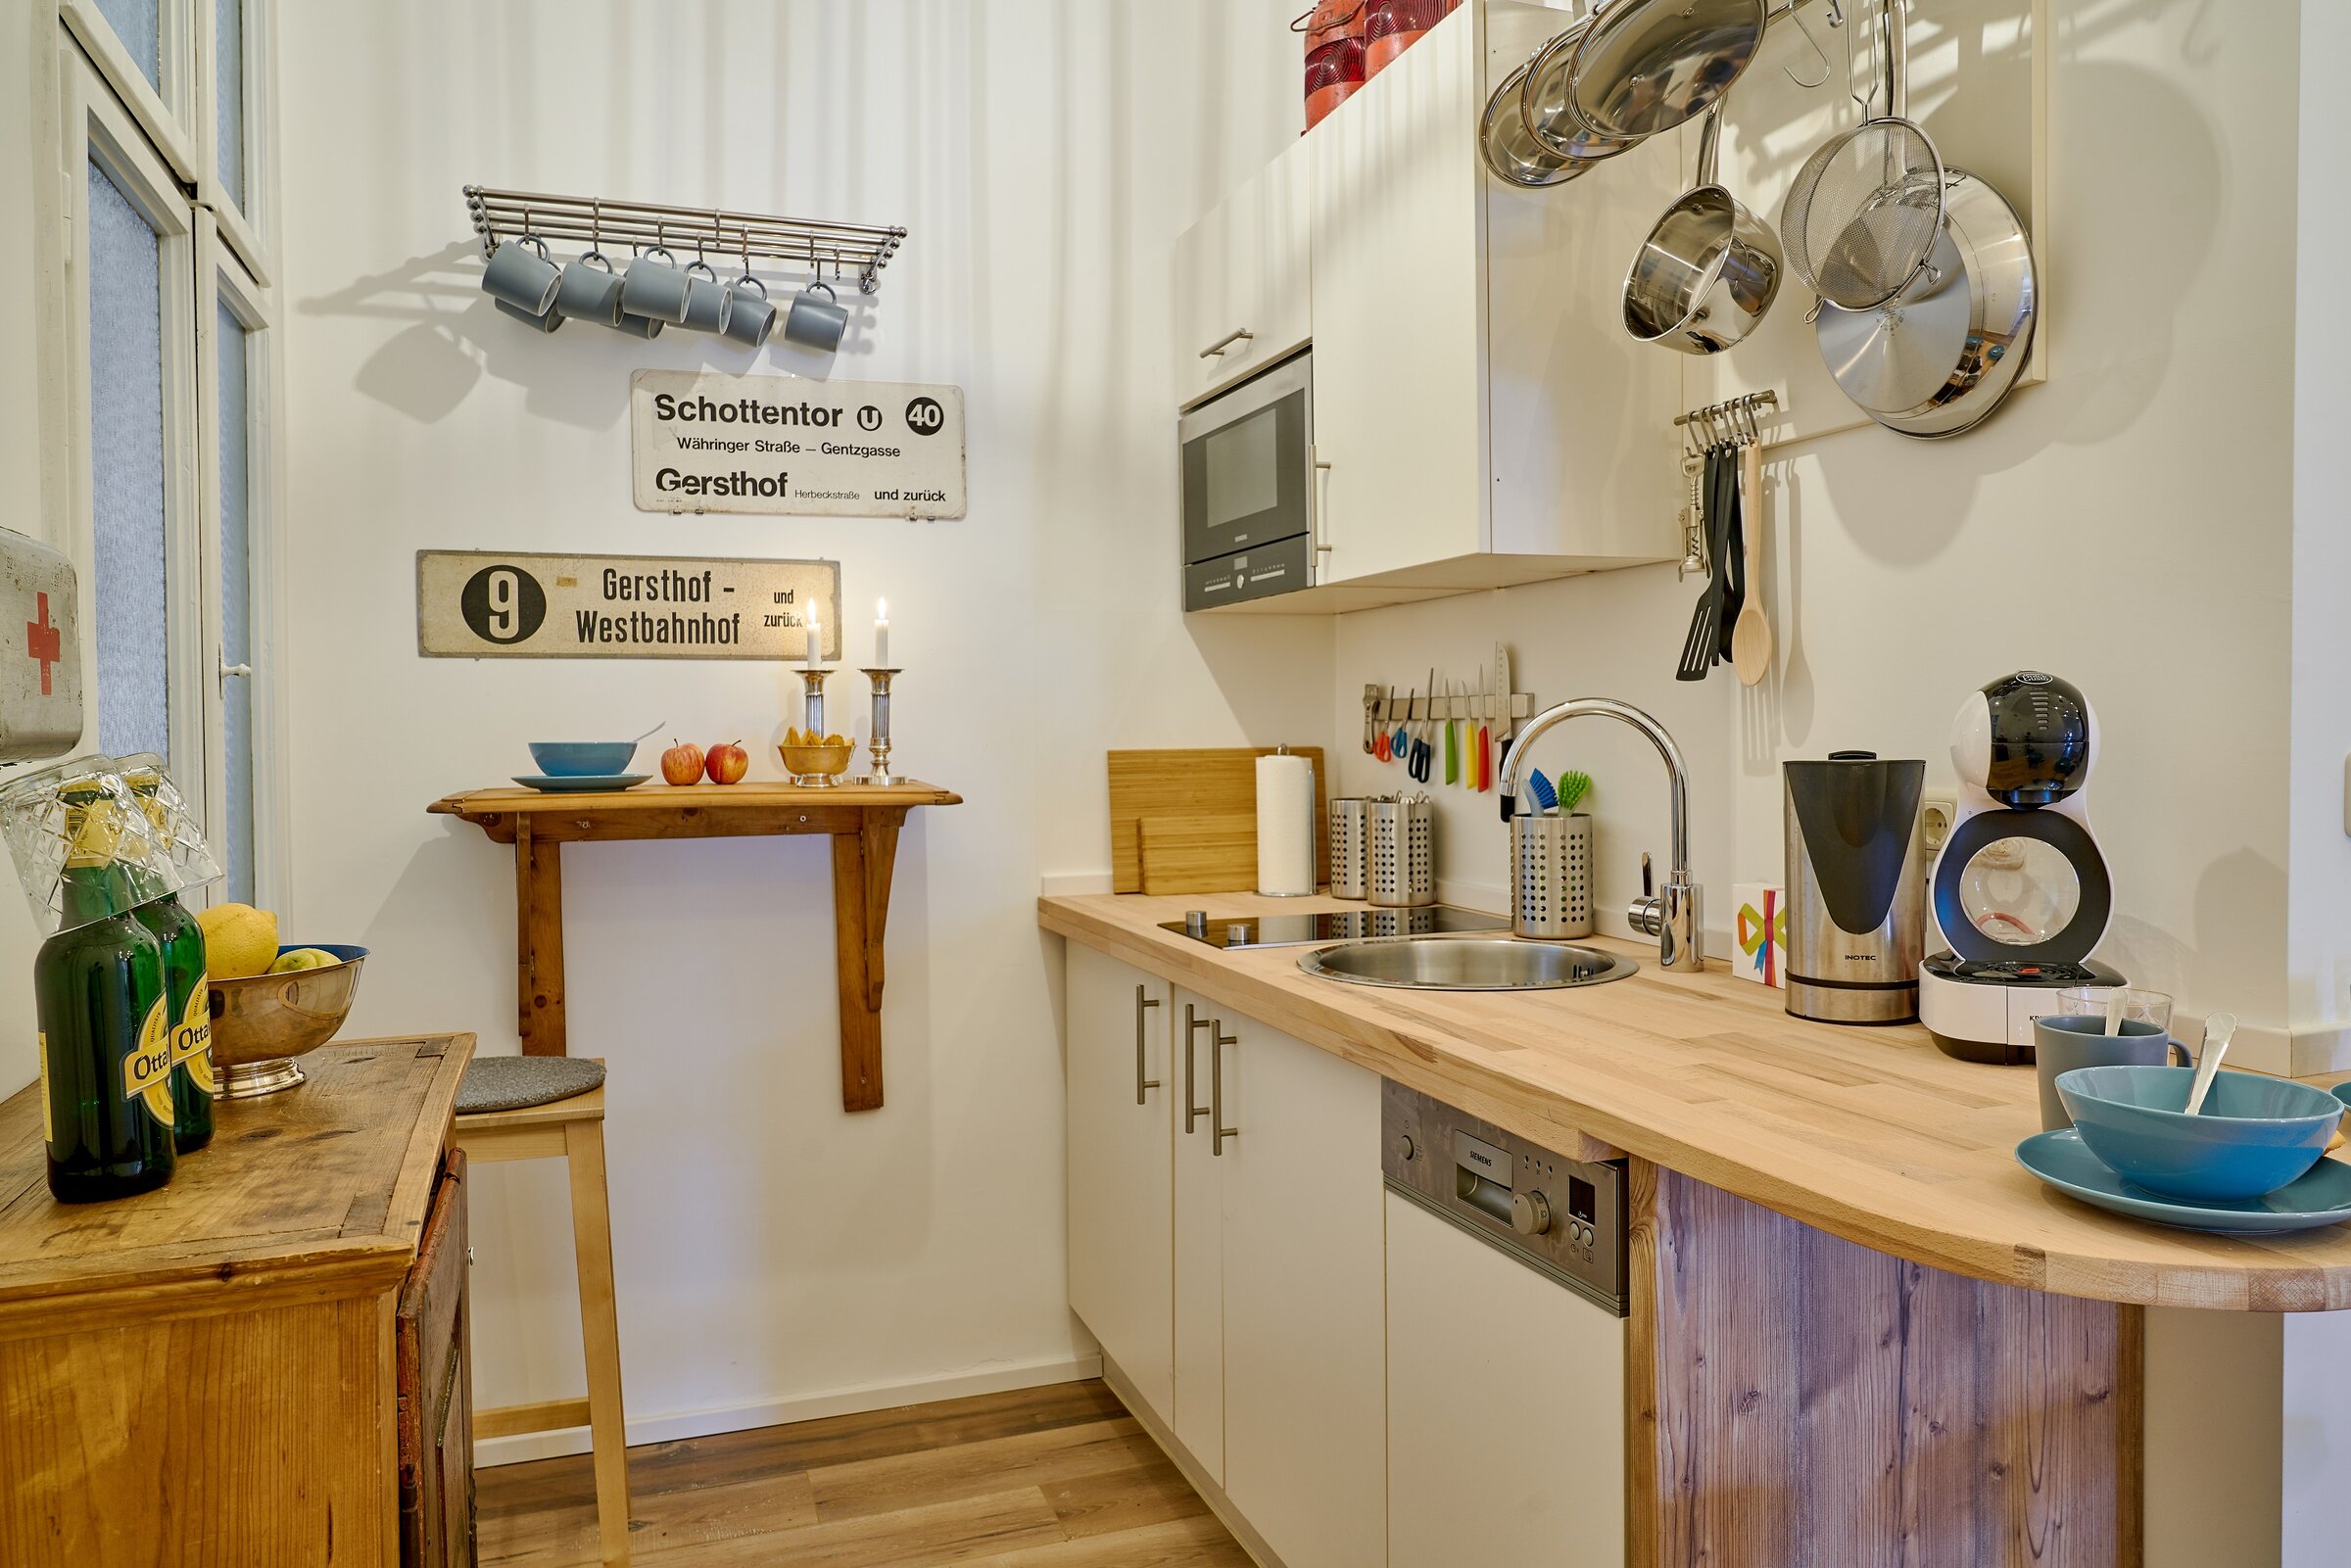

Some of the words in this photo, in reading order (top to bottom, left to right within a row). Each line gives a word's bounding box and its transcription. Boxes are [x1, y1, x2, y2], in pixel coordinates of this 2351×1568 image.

[654, 394, 843, 428] Schottentor
[908, 404, 941, 427] 40
[677, 437, 750, 453] Währinger
[754, 440, 800, 454] Straße
[820, 442, 901, 458] Gentzgasse
[655, 467, 789, 498] Gersthof
[794, 489, 860, 500] Herbeckstraße
[874, 490, 899, 501] und
[902, 490, 946, 502] zurück
[602, 568, 712, 603] Gersthof
[774, 590, 794, 605] und
[489, 570, 519, 640] 9
[763, 611, 803, 629] zurück
[576, 610, 741, 644] Westbahnhof
[1469, 1150, 1492, 1166] SIEMENS
